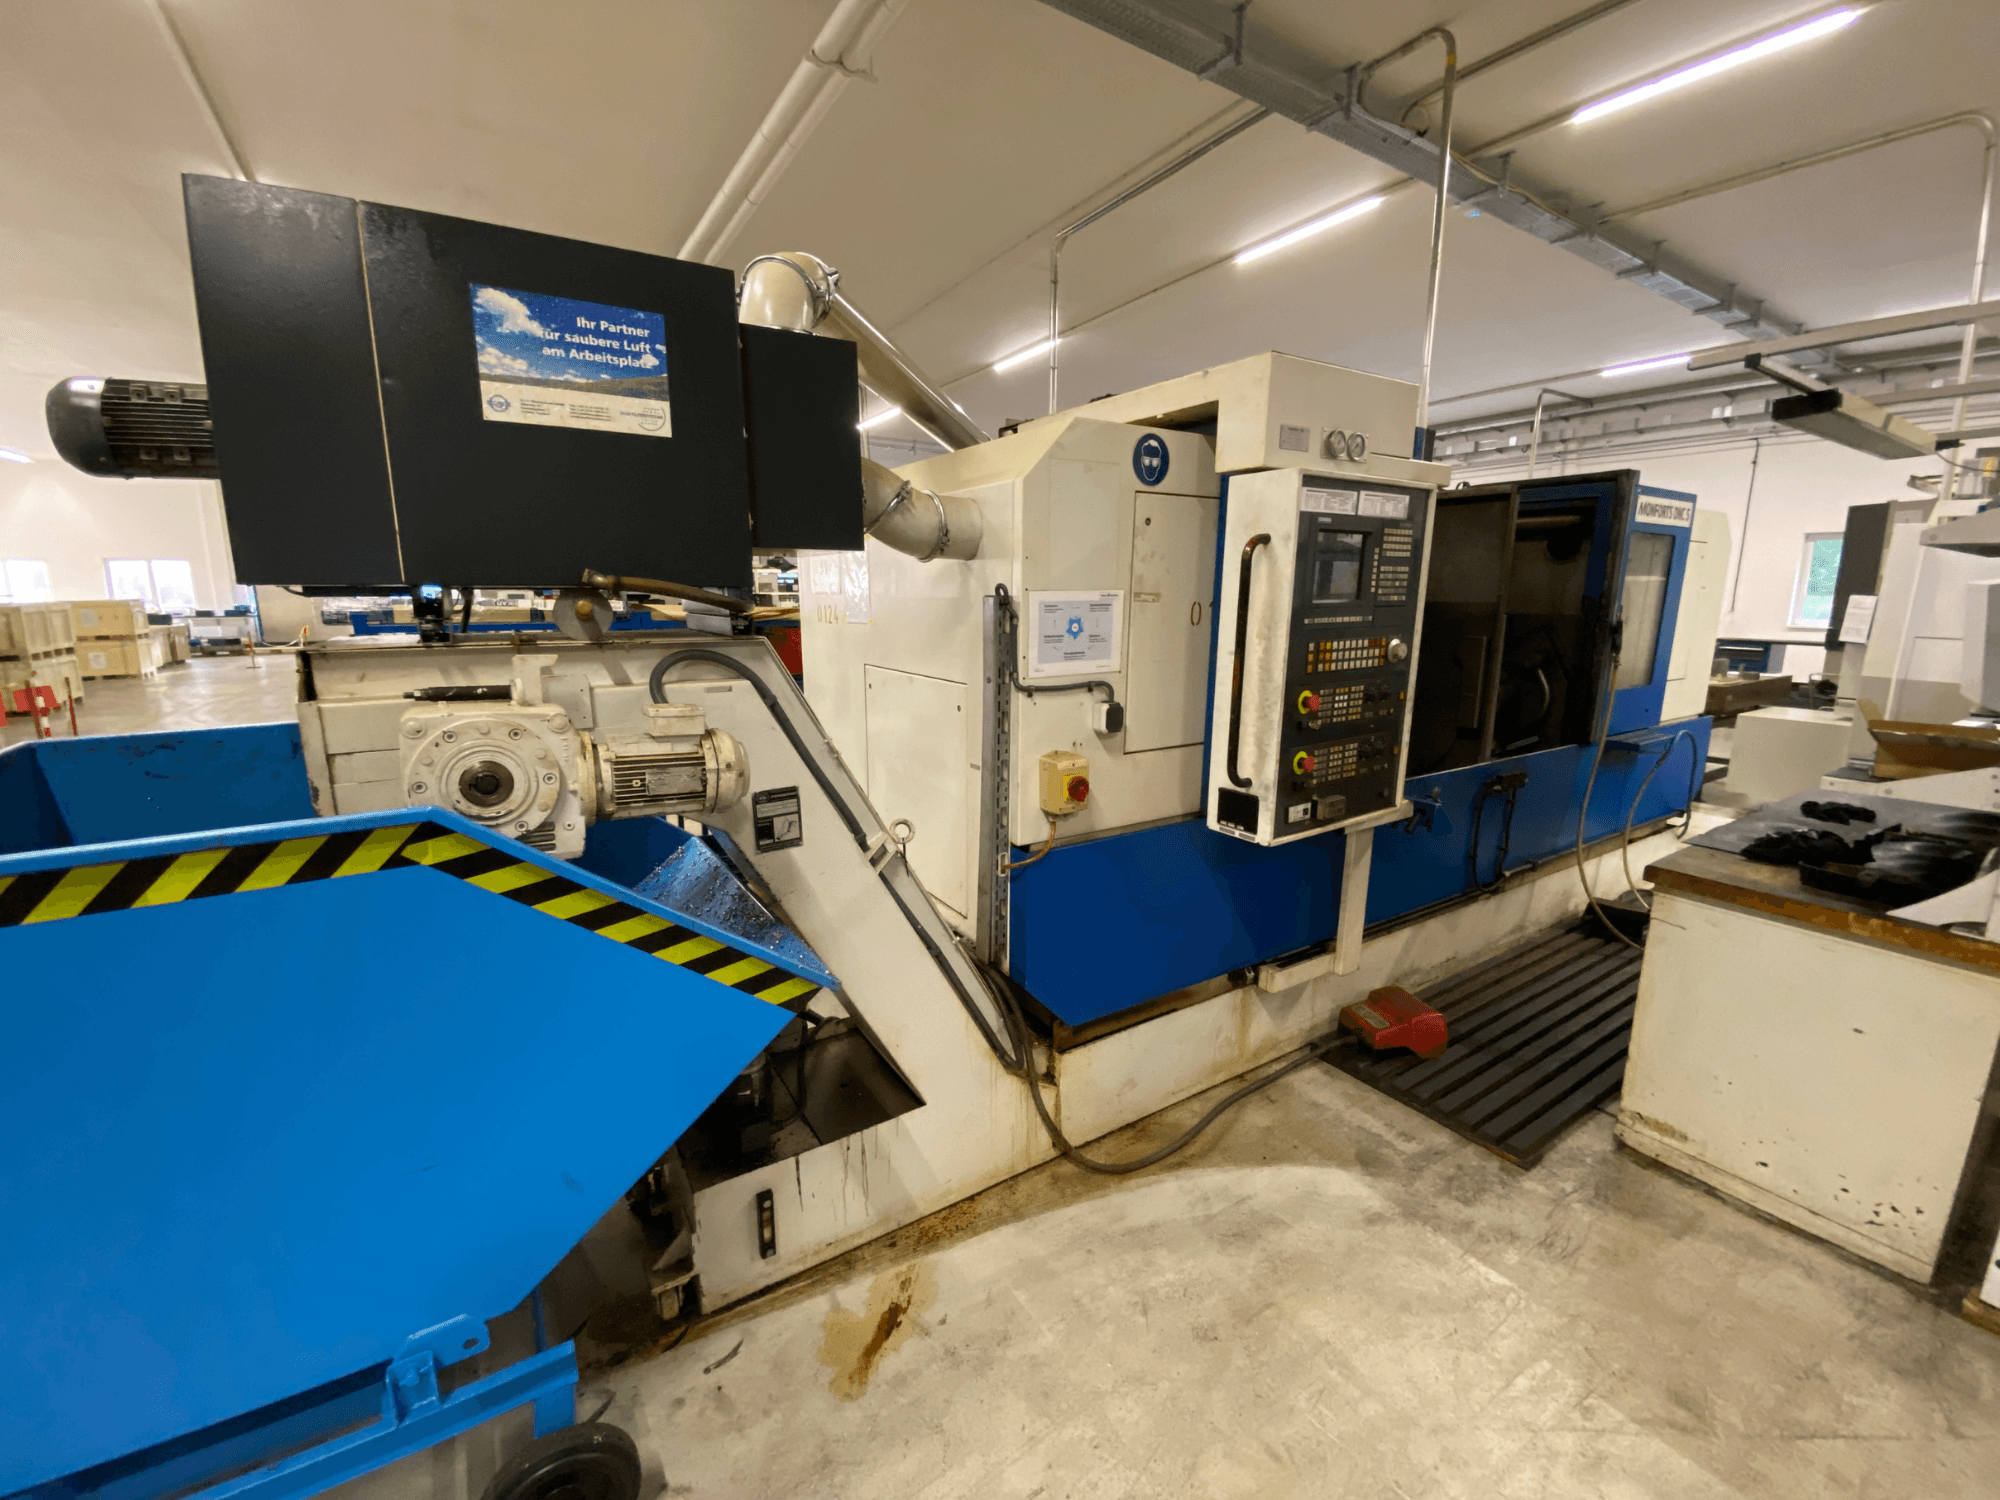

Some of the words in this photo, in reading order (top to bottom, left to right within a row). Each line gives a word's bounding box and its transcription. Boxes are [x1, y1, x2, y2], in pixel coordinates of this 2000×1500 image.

[576, 316, 597, 330] Ihr
[600, 320, 650, 338] Partner
[542, 346, 565, 358] am
[564, 333, 620, 349] saubere
[623, 340, 651, 354] Luft
[1637, 501, 1673, 519] MONFORTS
[816, 604, 839, 625] 0124
